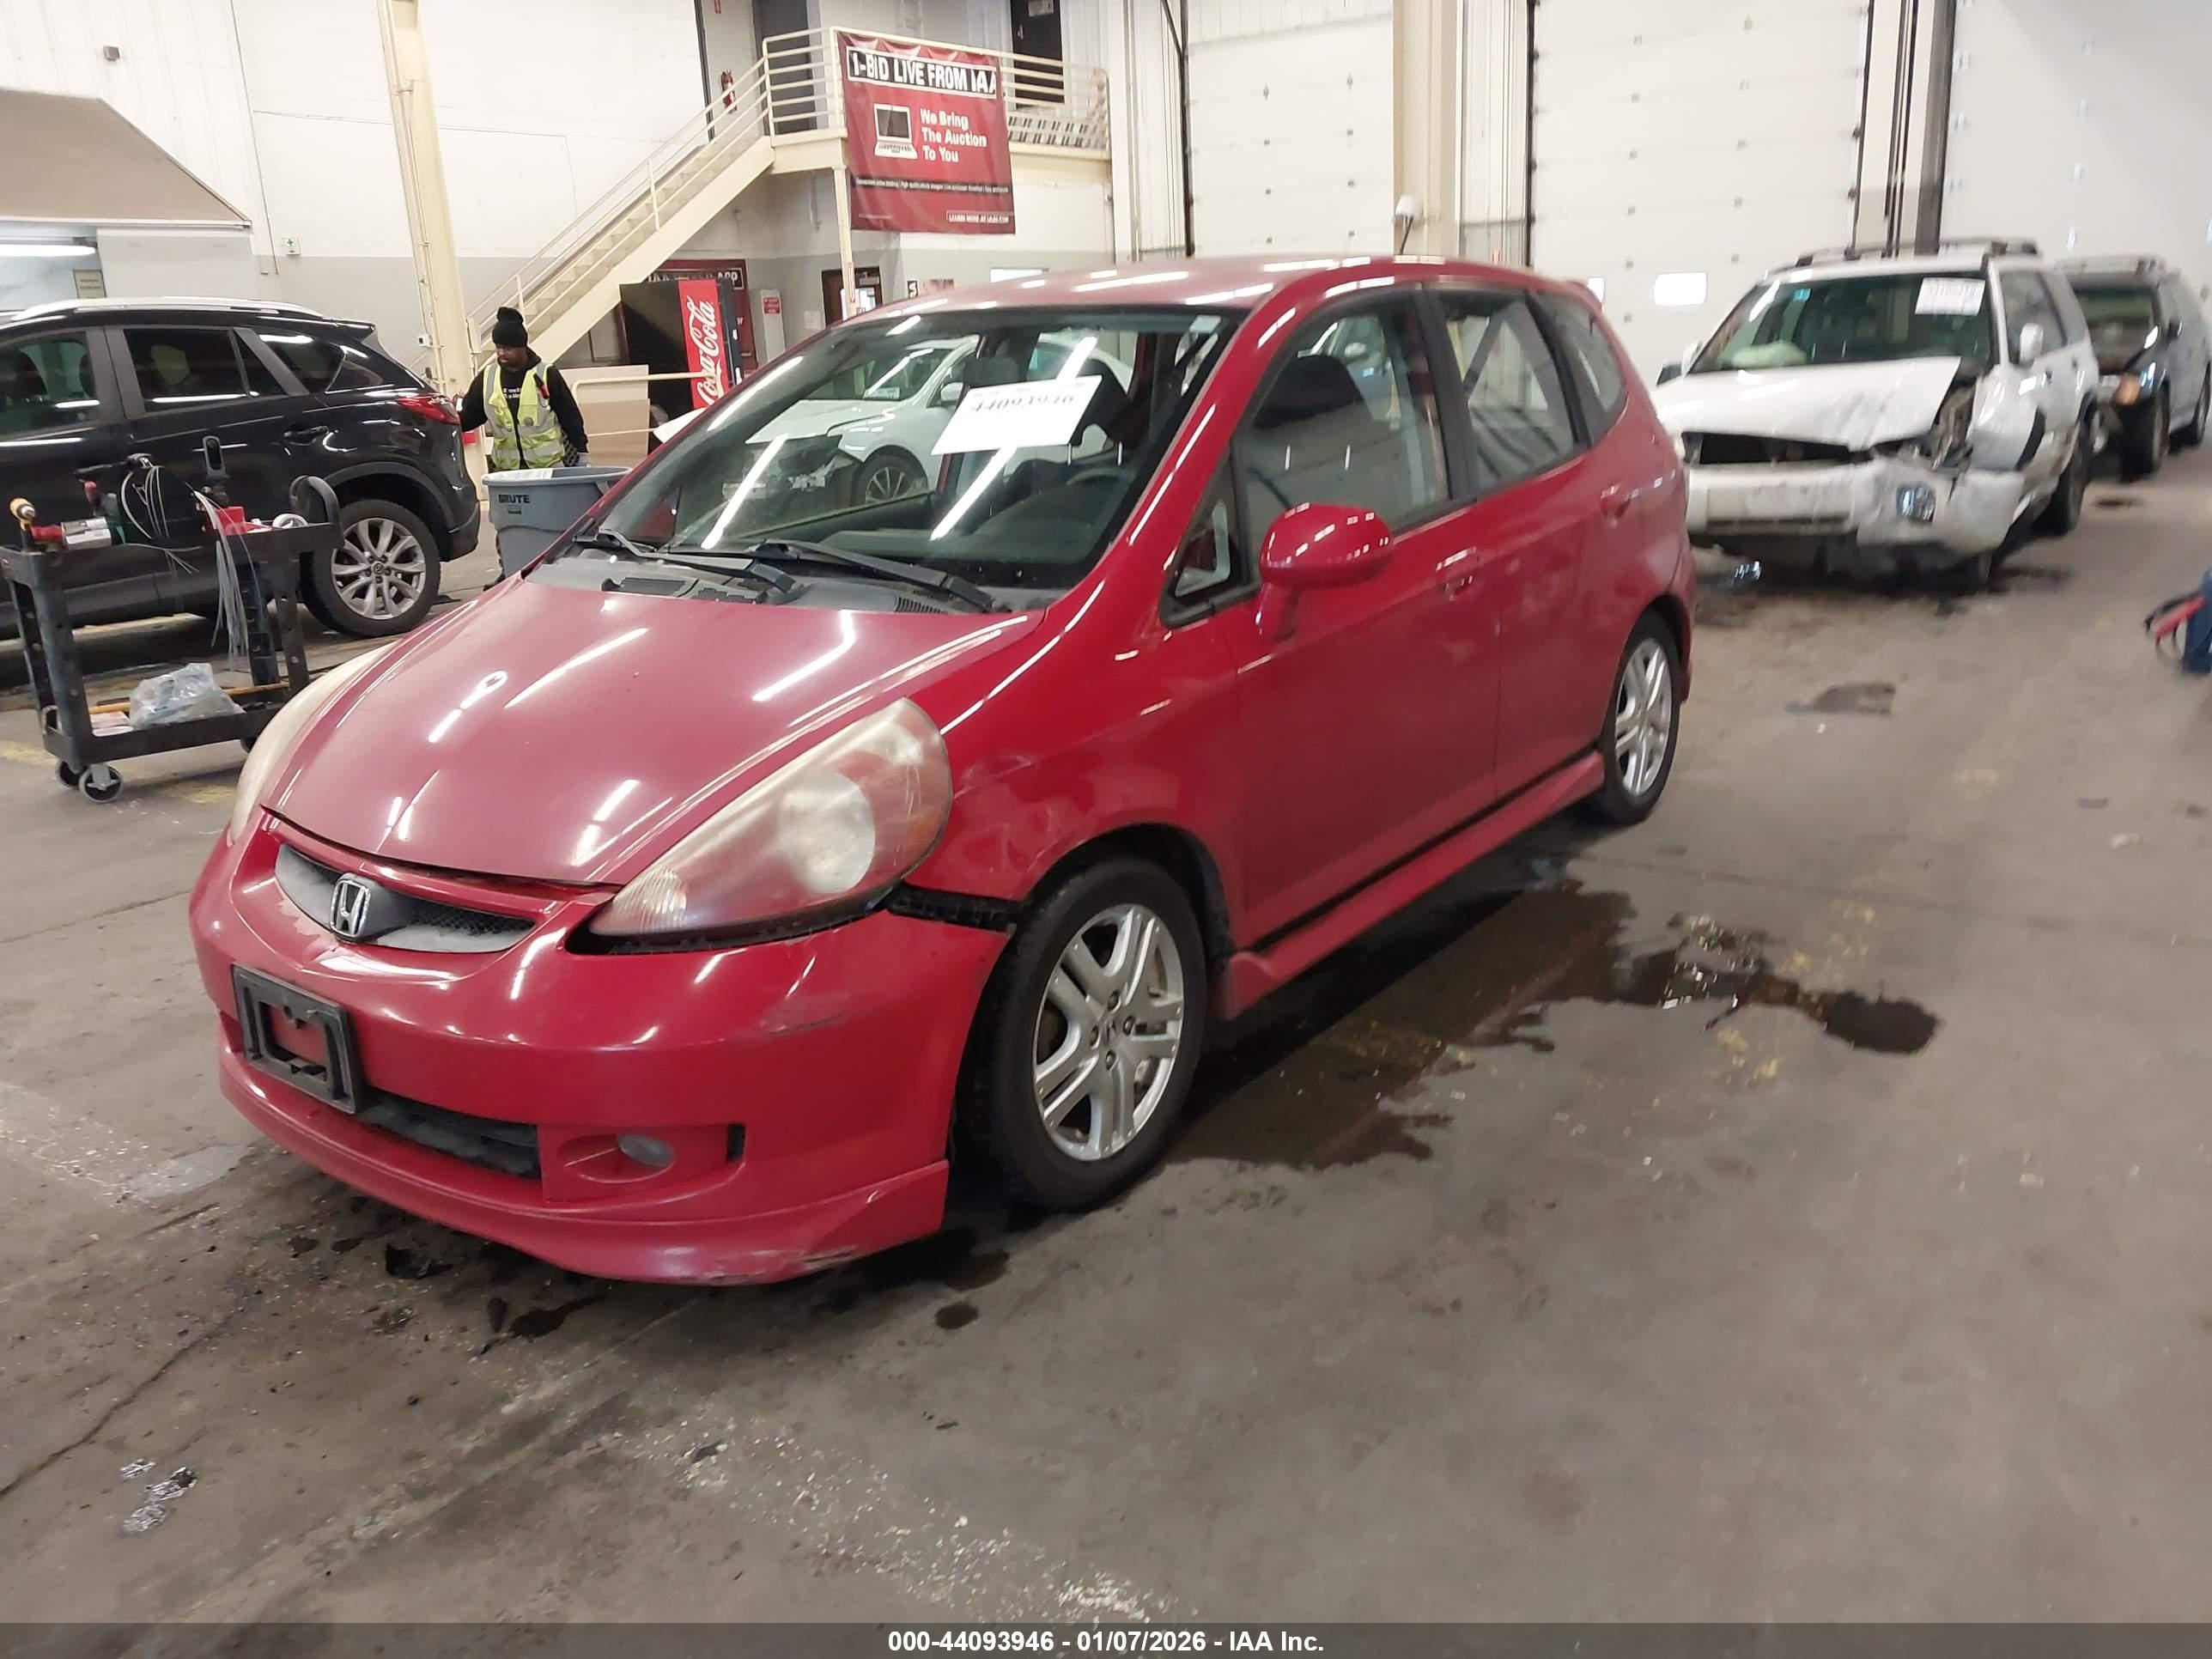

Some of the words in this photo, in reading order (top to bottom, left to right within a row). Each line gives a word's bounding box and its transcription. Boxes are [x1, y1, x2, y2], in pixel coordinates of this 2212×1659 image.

[894, 58, 926, 86] LIVE
[927, 63, 968, 91] FROM
[920, 107, 938, 125] We
[939, 110, 969, 131] Bring
[921, 126, 942, 143] The
[945, 128, 988, 148] Auction
[922, 144, 937, 161] To
[939, 146, 959, 163] You
[498, 494, 531, 504] BRUTE
